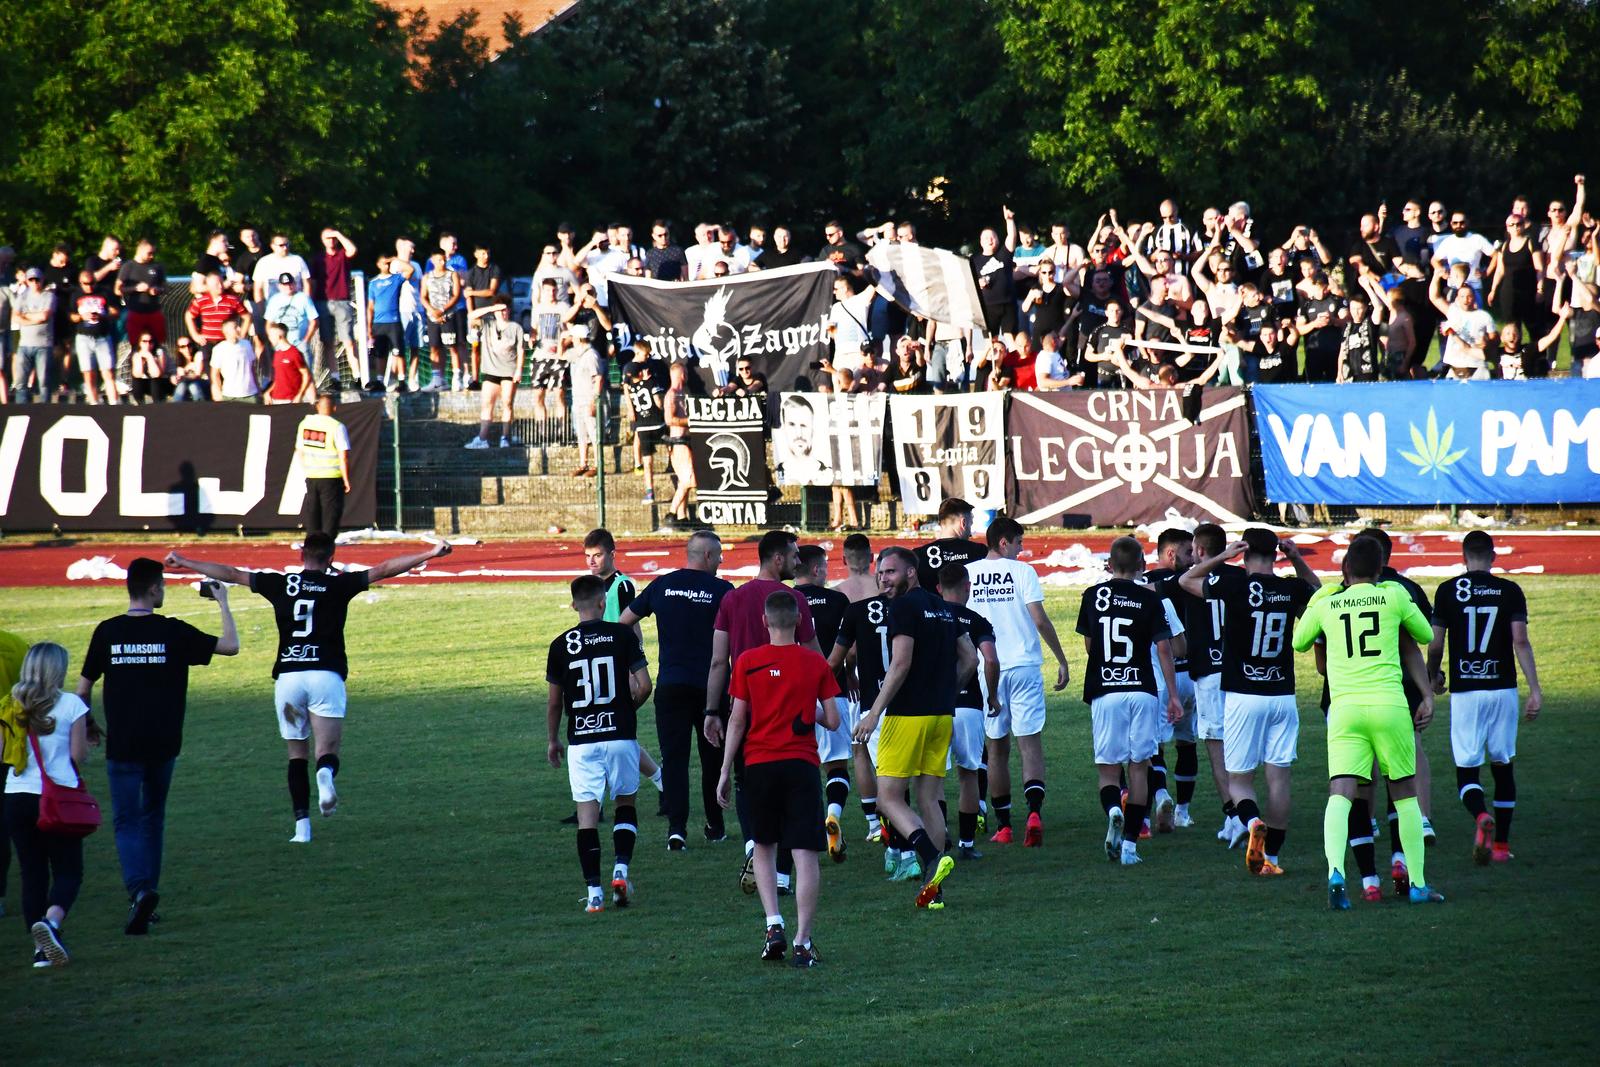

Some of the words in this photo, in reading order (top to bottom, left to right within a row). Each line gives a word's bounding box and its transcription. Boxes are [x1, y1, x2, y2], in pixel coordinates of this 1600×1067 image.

[686, 396, 763, 421] LEGIJA
[1087, 390, 1183, 421] CRNA
[968, 406, 986, 436] 9
[920, 443, 979, 467] Legija
[1267, 411, 1387, 478] VAN
[914, 471, 931, 501] 8
[973, 469, 990, 499] 9
[699, 502, 768, 525] CENTAR
[972, 585, 1014, 598] prijevozi
[973, 572, 1014, 586] JURA
[1113, 598, 1142, 609] Svjetlost
[1330, 600, 1342, 609] NK
[1343, 595, 1387, 608] MARSONIA
[292, 599, 315, 638] 9
[1463, 606, 1499, 653] 17
[584, 635, 614, 646] Svjetlost
[1099, 616, 1133, 663] 15
[1251, 611, 1287, 658] 18
[1339, 611, 1381, 658] 12
[111, 644, 122, 654] NK
[123, 643, 166, 654] MARSONIA
[568, 656, 616, 709] 30
[769, 669, 781, 677] TM
